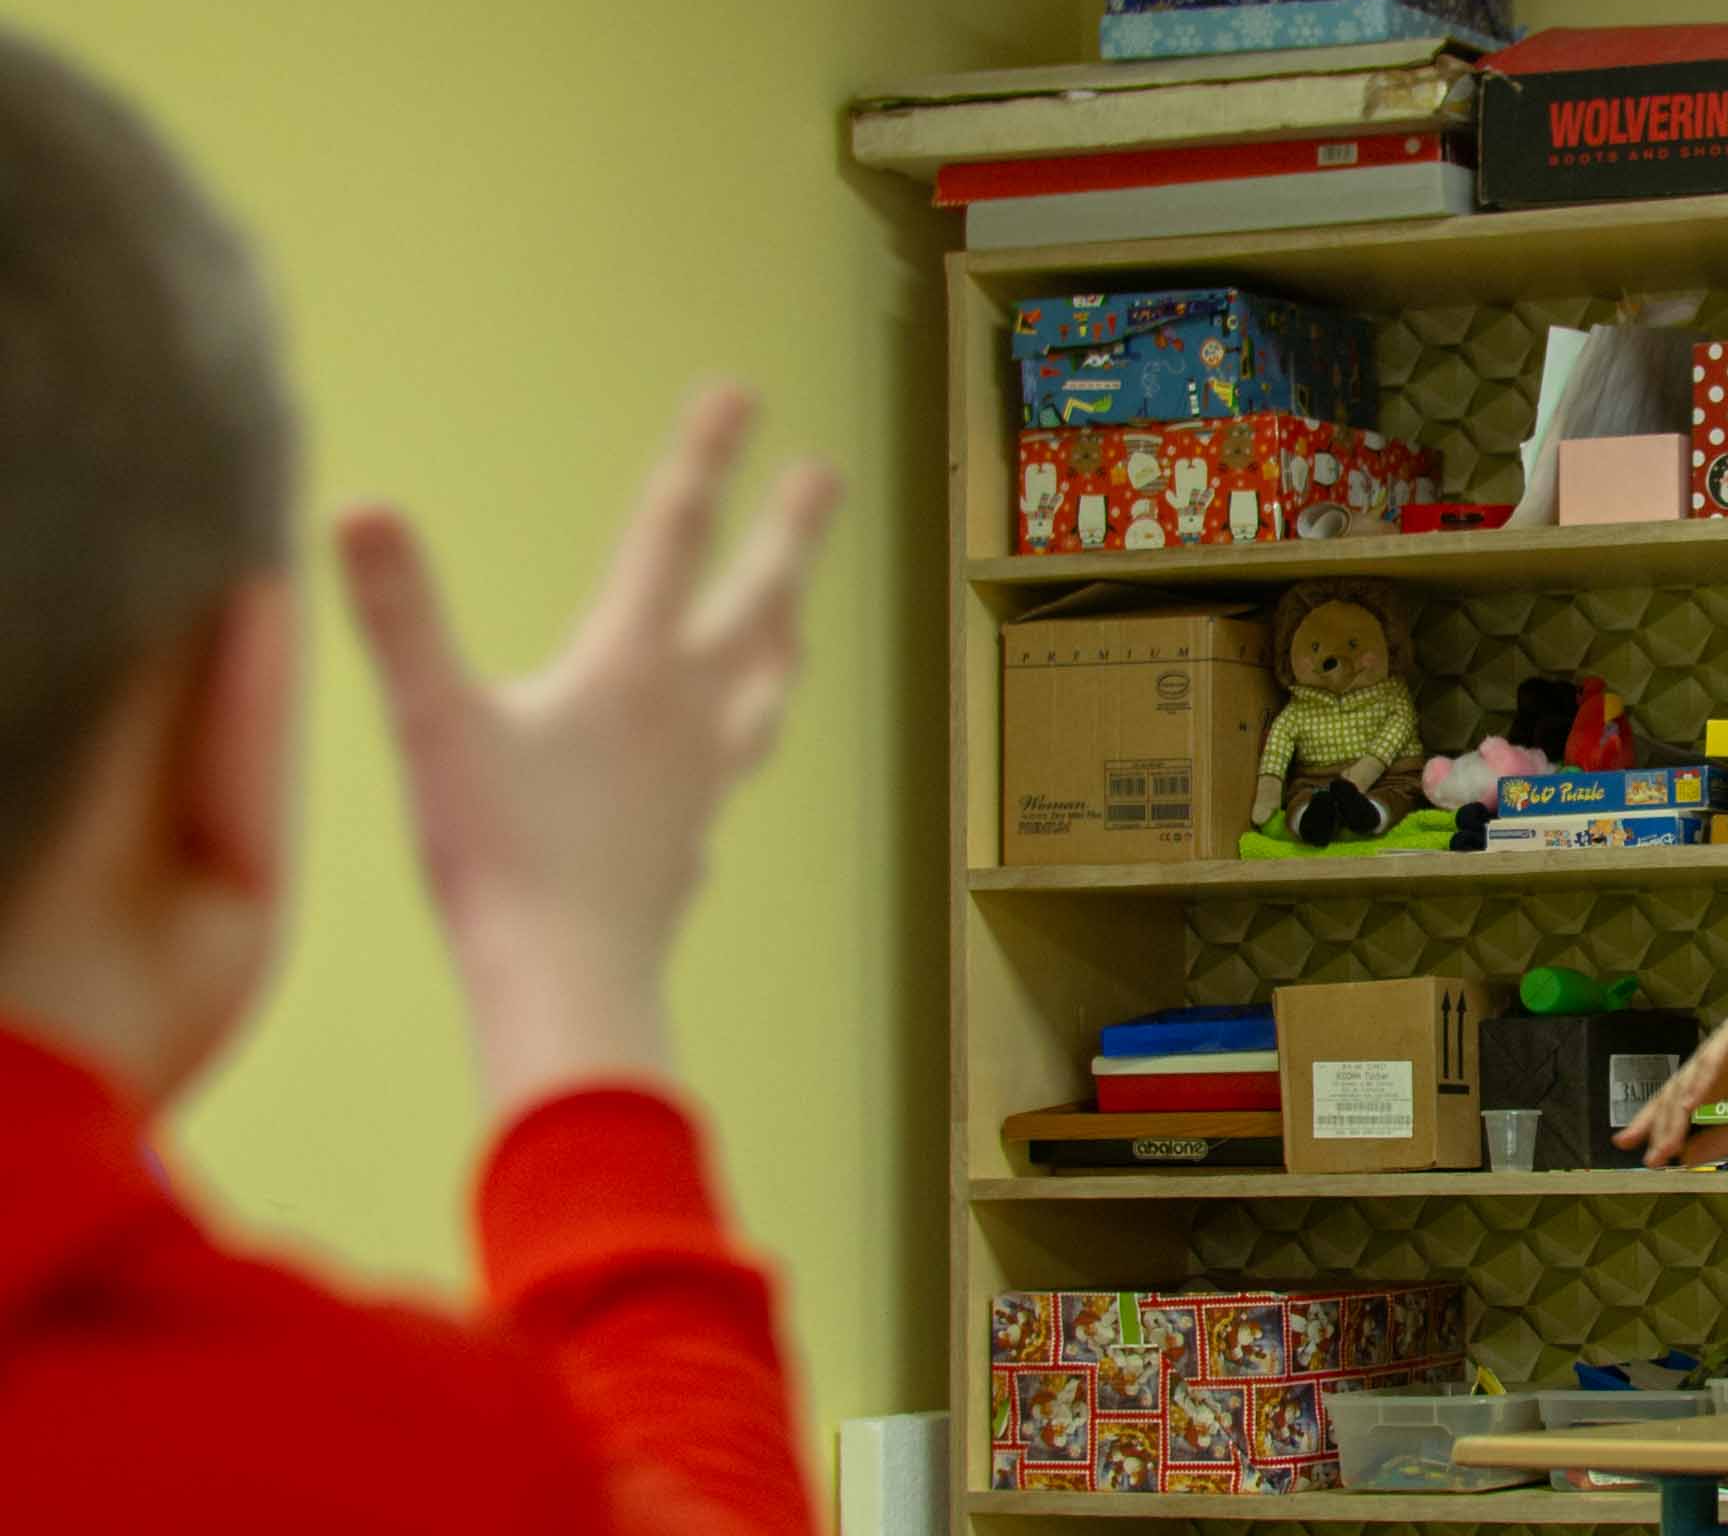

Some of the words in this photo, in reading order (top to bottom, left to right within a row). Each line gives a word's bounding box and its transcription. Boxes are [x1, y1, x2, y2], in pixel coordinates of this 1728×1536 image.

[1547, 150, 1618, 168] BOOTS
[1627, 146, 1671, 161] AND
[1560, 780, 1605, 803] Puzzle
[1137, 1139, 1203, 1154] abalone
